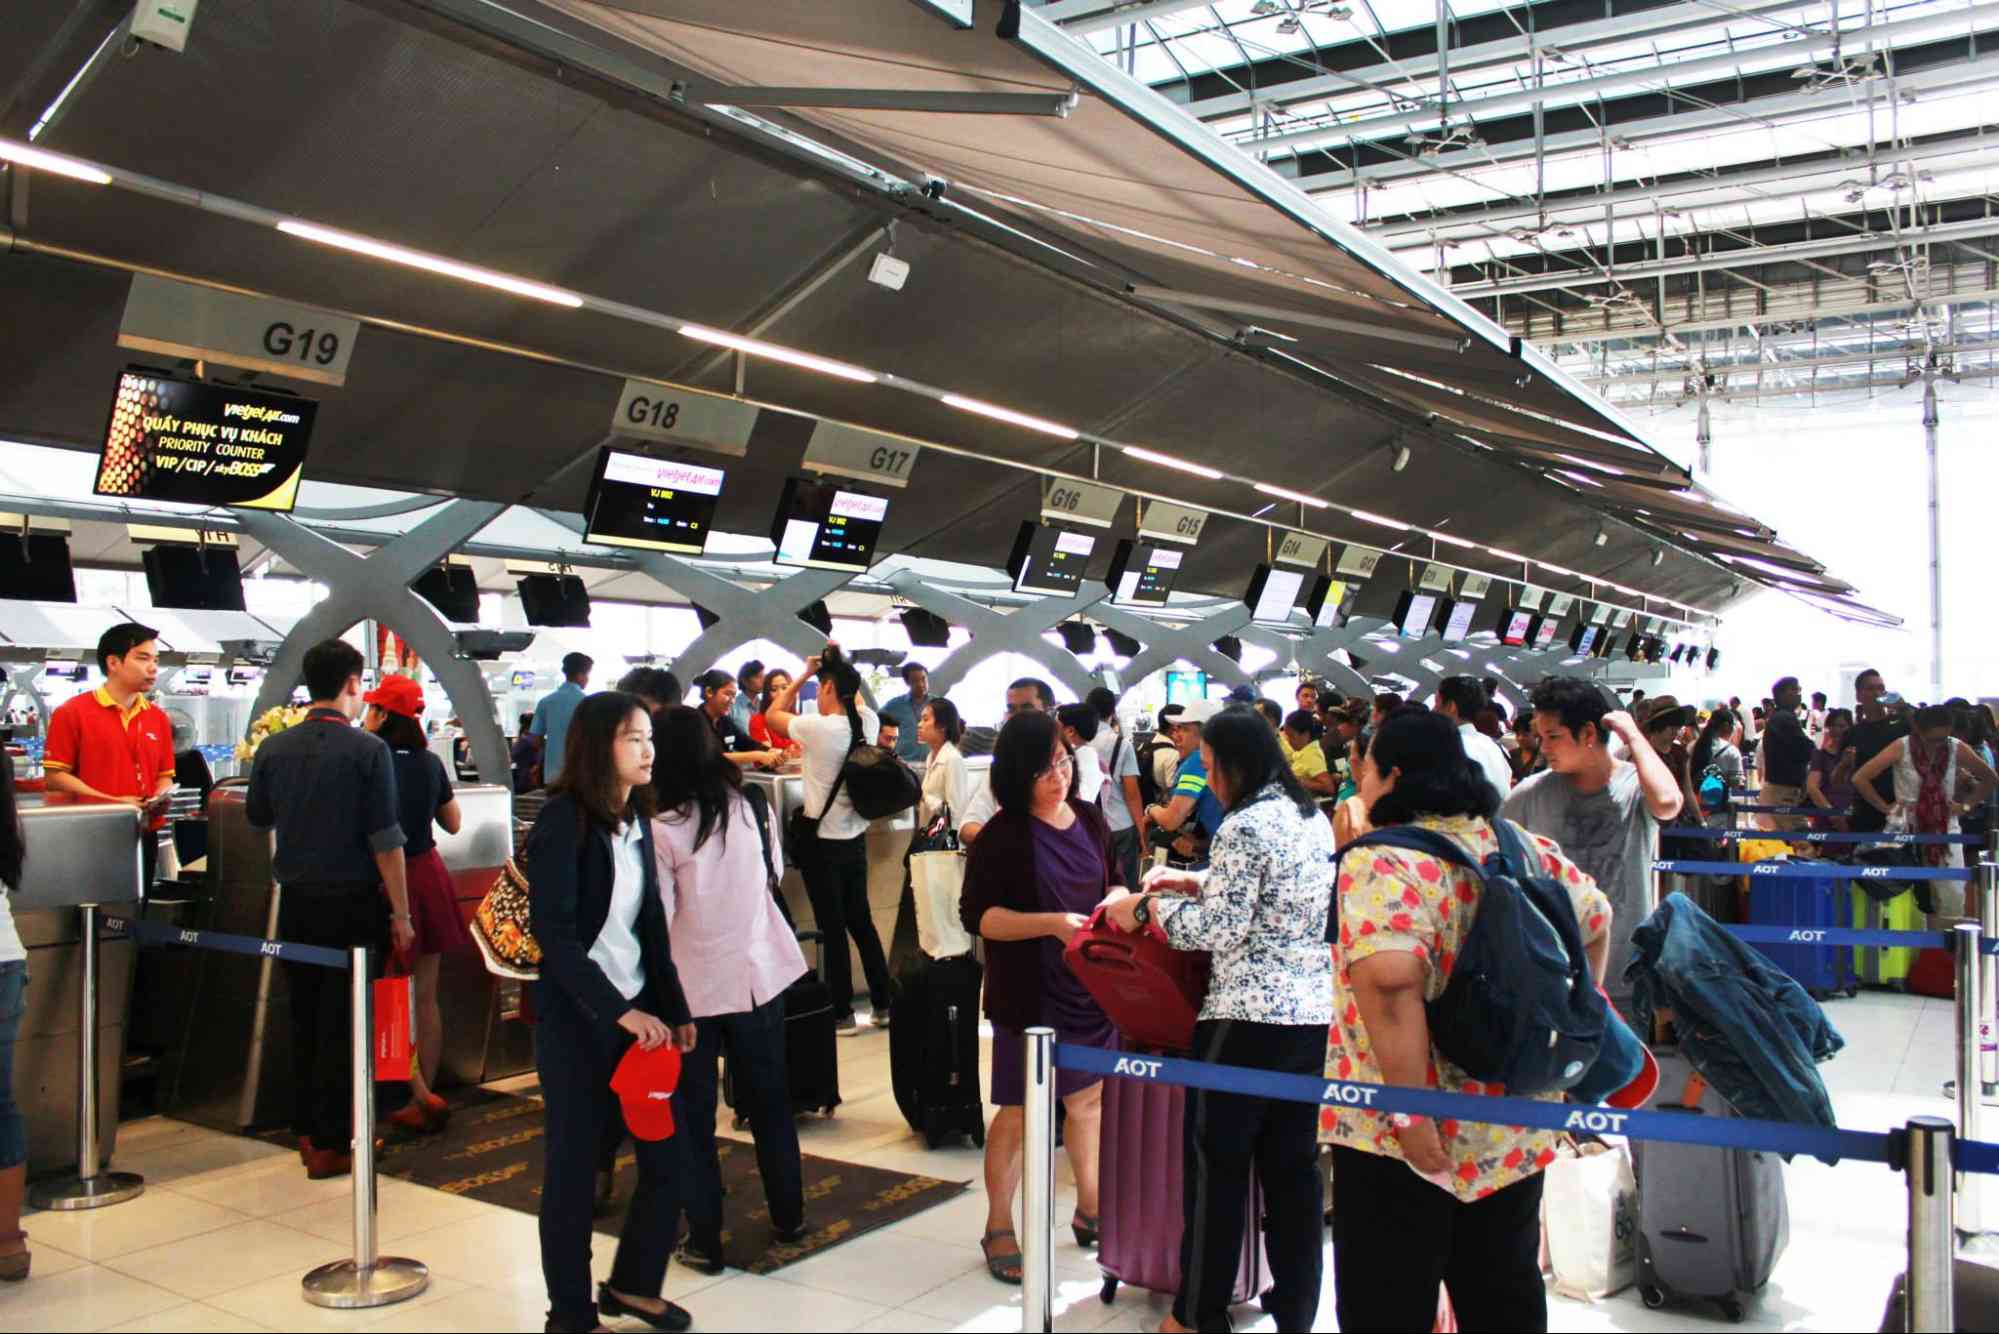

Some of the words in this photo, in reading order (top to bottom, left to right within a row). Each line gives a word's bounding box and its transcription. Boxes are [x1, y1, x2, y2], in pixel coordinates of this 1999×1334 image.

[263, 322, 339, 365] G19
[627, 396, 679, 429] G18
[240, 428, 283, 446] KHÁCH
[158, 437, 211, 453] PRIORITY
[215, 443, 265, 460] COUNTER
[871, 447, 911, 472] G17
[1051, 488, 1081, 510] G16
[1176, 516, 1200, 535] G15
[1723, 830, 1743, 838] AOT
[1806, 833, 1828, 841] AOT
[1894, 834, 1916, 843] AOT
[1753, 865, 1779, 874] AOT
[1862, 867, 1890, 877] AOT
[106, 918, 124, 930] AOT
[180, 930, 199, 943] AOT
[1789, 930, 1826, 941] AOT
[261, 942, 282, 955] AOT
[1114, 1057, 1163, 1078] AOT
[1322, 1083, 1378, 1105] AOT
[1565, 1110, 1628, 1132] AOT
